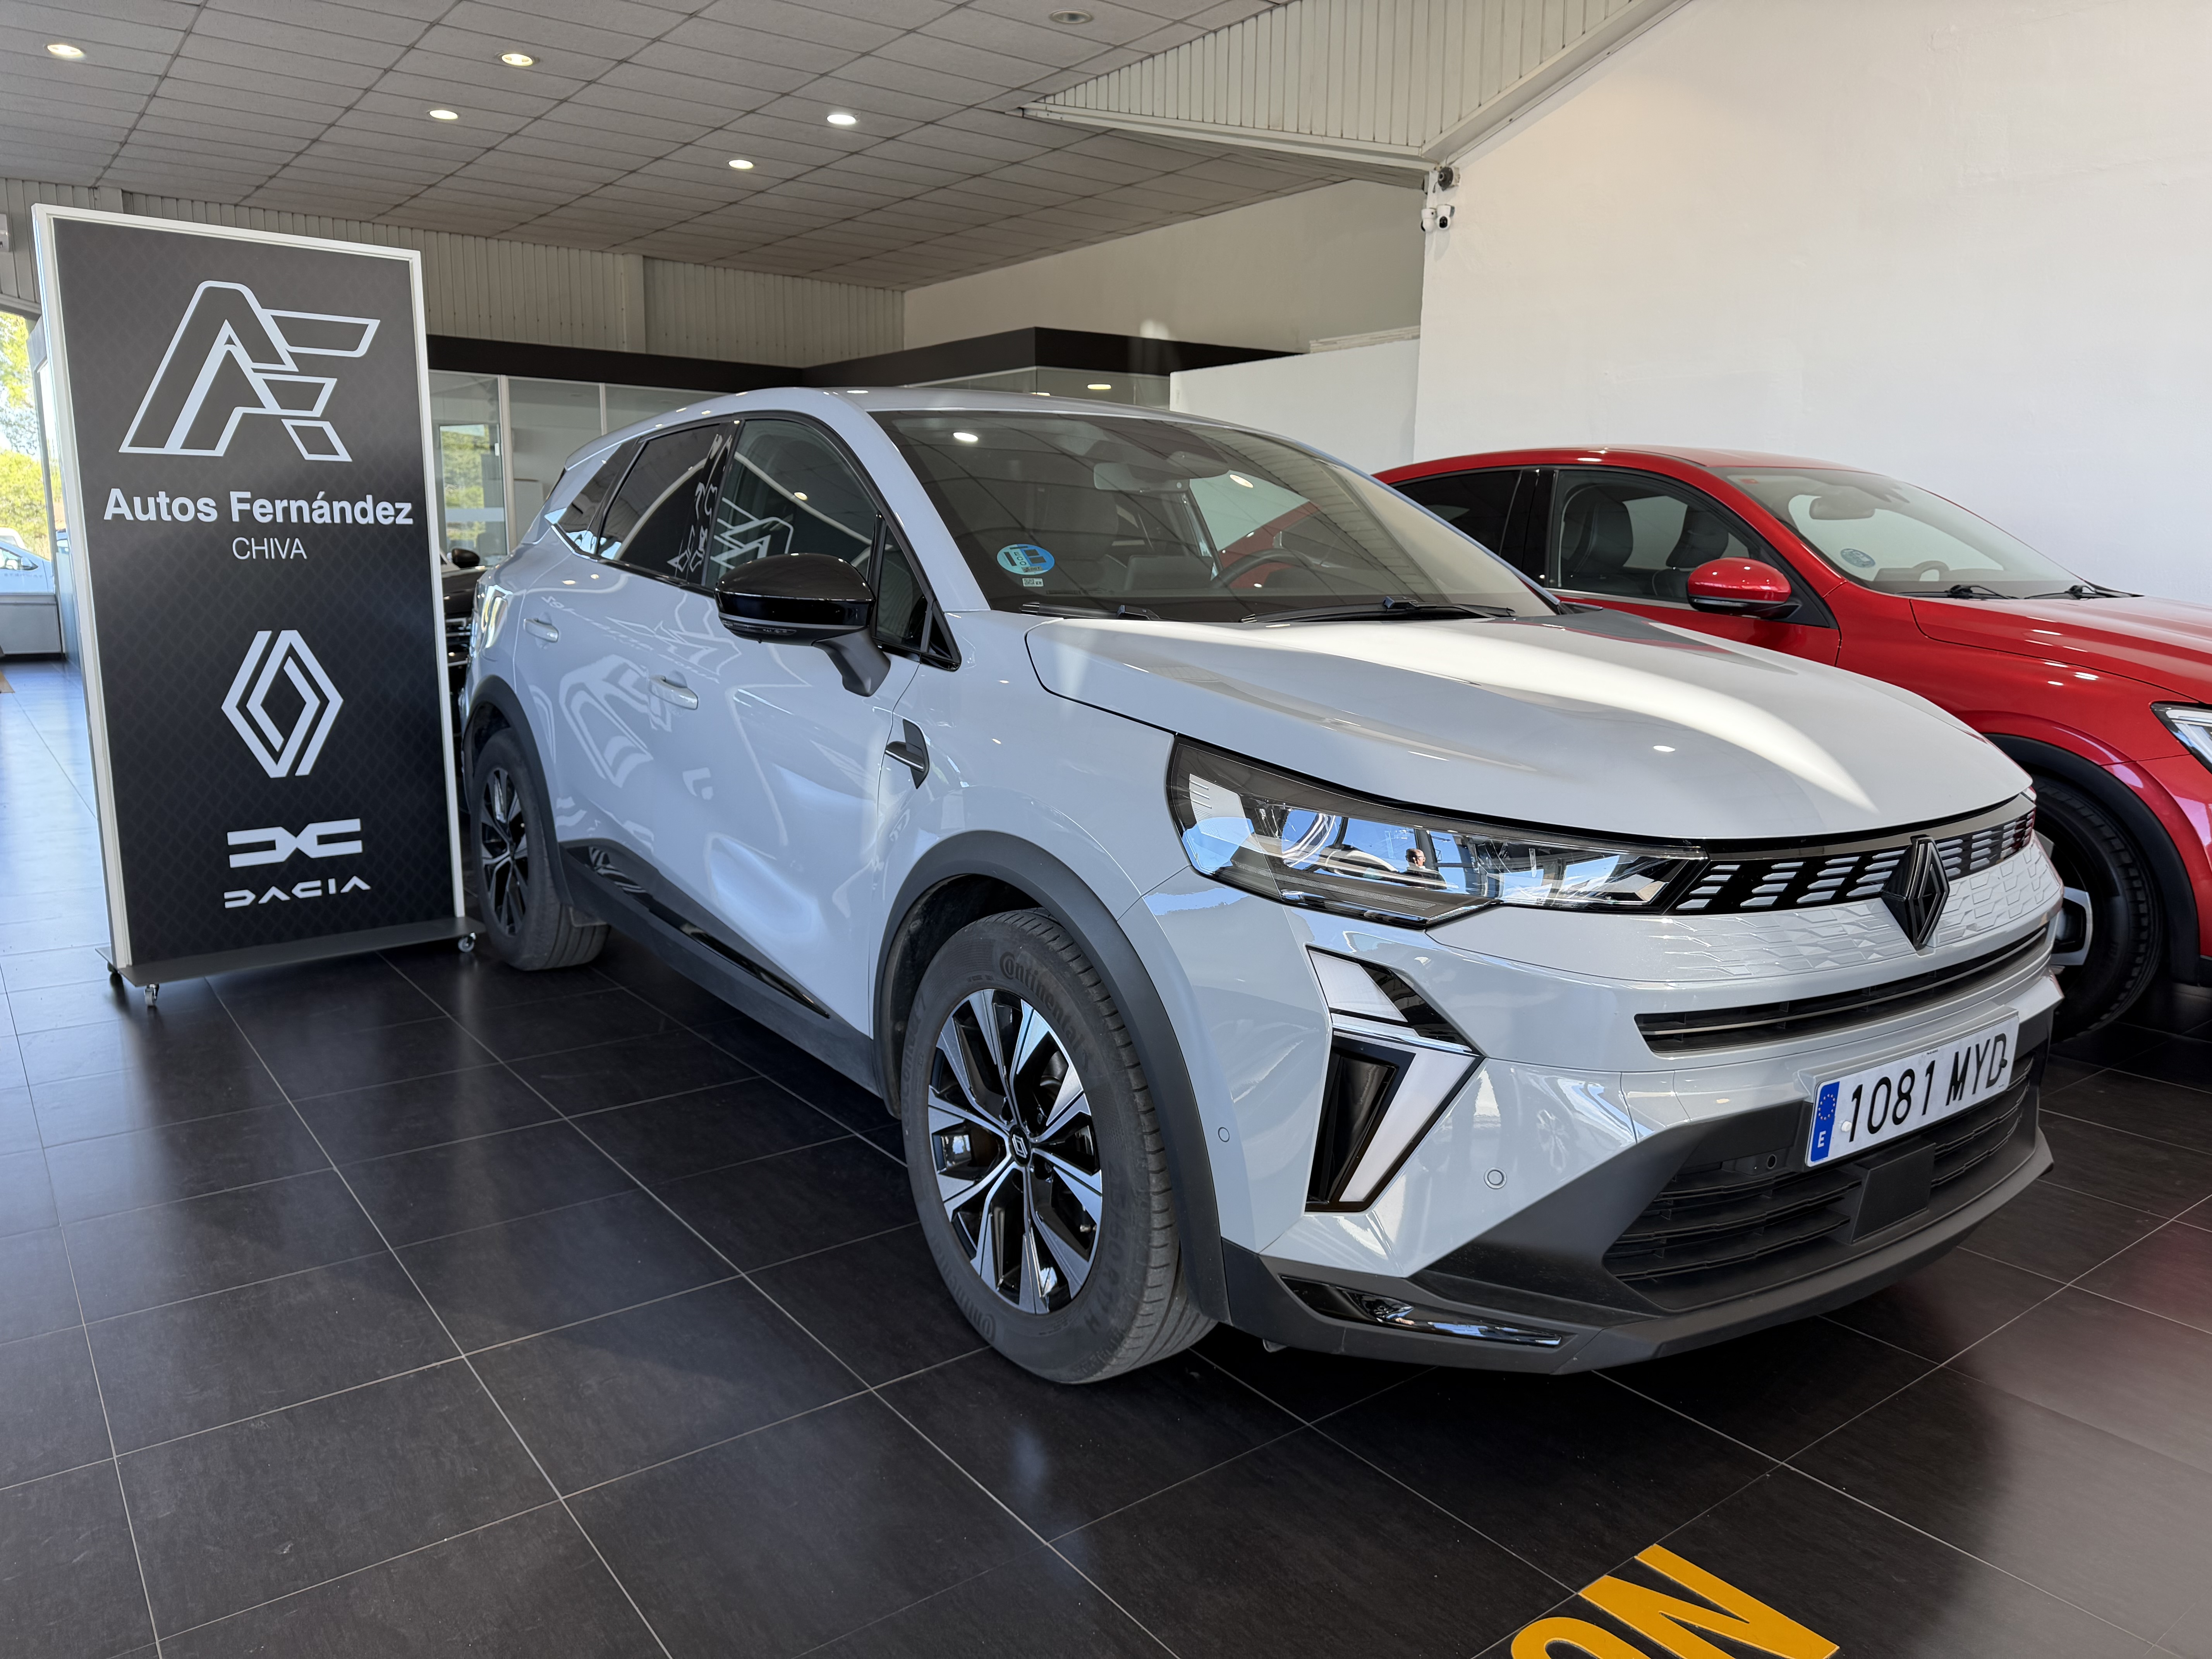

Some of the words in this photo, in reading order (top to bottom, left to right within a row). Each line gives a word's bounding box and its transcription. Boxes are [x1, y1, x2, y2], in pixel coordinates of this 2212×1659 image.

[104, 488, 217, 522] Autos
[230, 491, 413, 524] Fernández
[233, 538, 307, 559] CHIVA
[1014, 551, 1027, 565] ECO
[224, 876, 370, 908] DACIA
[999, 951, 1085, 1053] Continental
[1849, 1060, 1936, 1142] 1081
[1946, 1033, 2006, 1106] MYD
[1817, 1130, 1826, 1148] E
